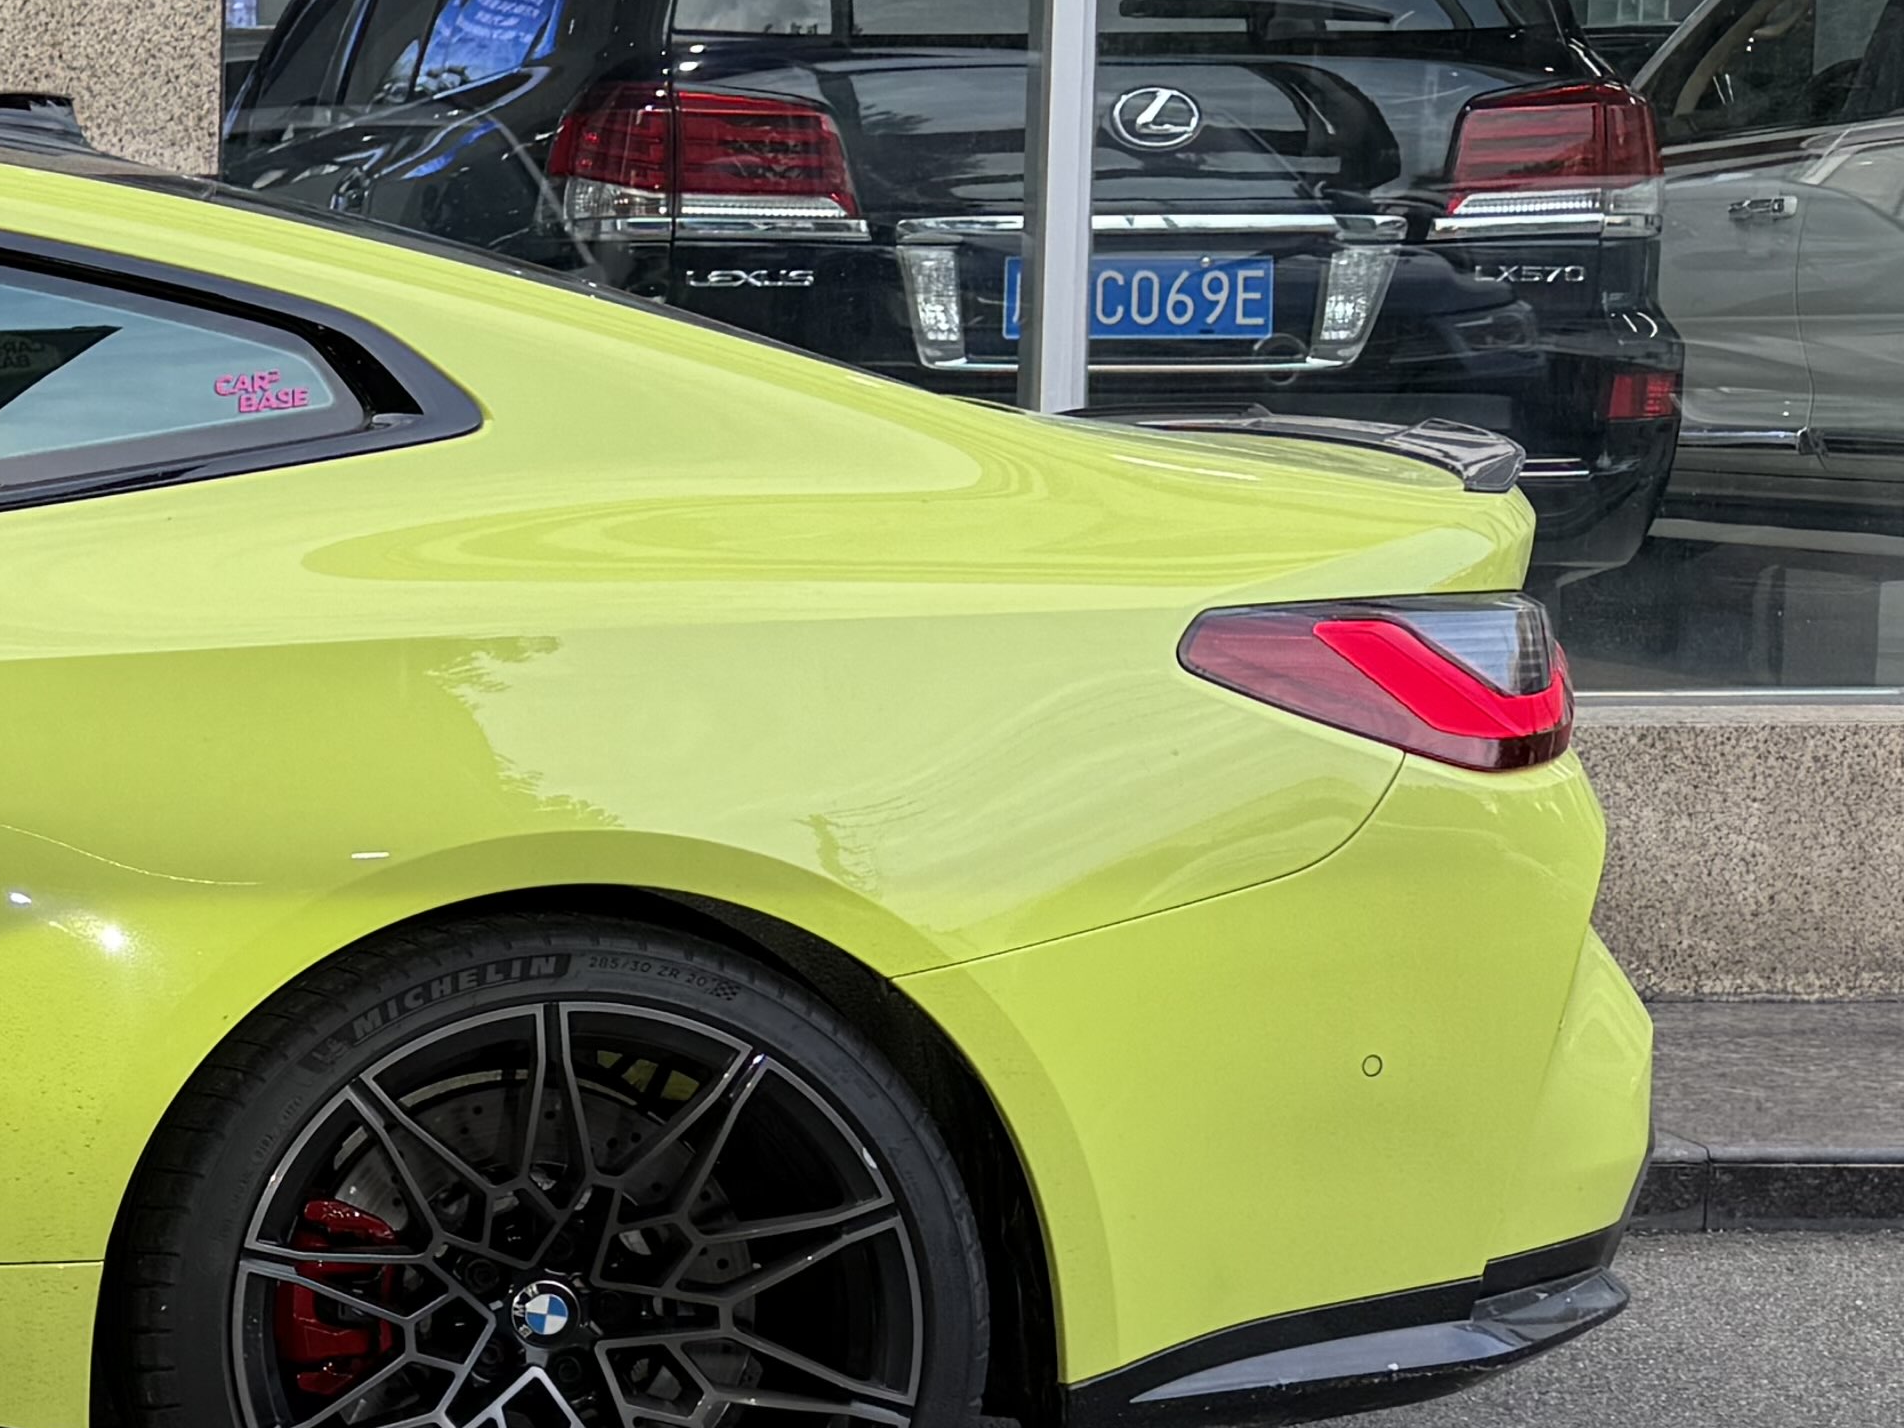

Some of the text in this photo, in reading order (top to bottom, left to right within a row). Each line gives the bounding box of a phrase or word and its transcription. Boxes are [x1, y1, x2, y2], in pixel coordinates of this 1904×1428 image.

[685, 270, 815, 287] LEXUS
[238, 388, 309, 414] BASE
[351, 954, 559, 1037] MICHELIN
